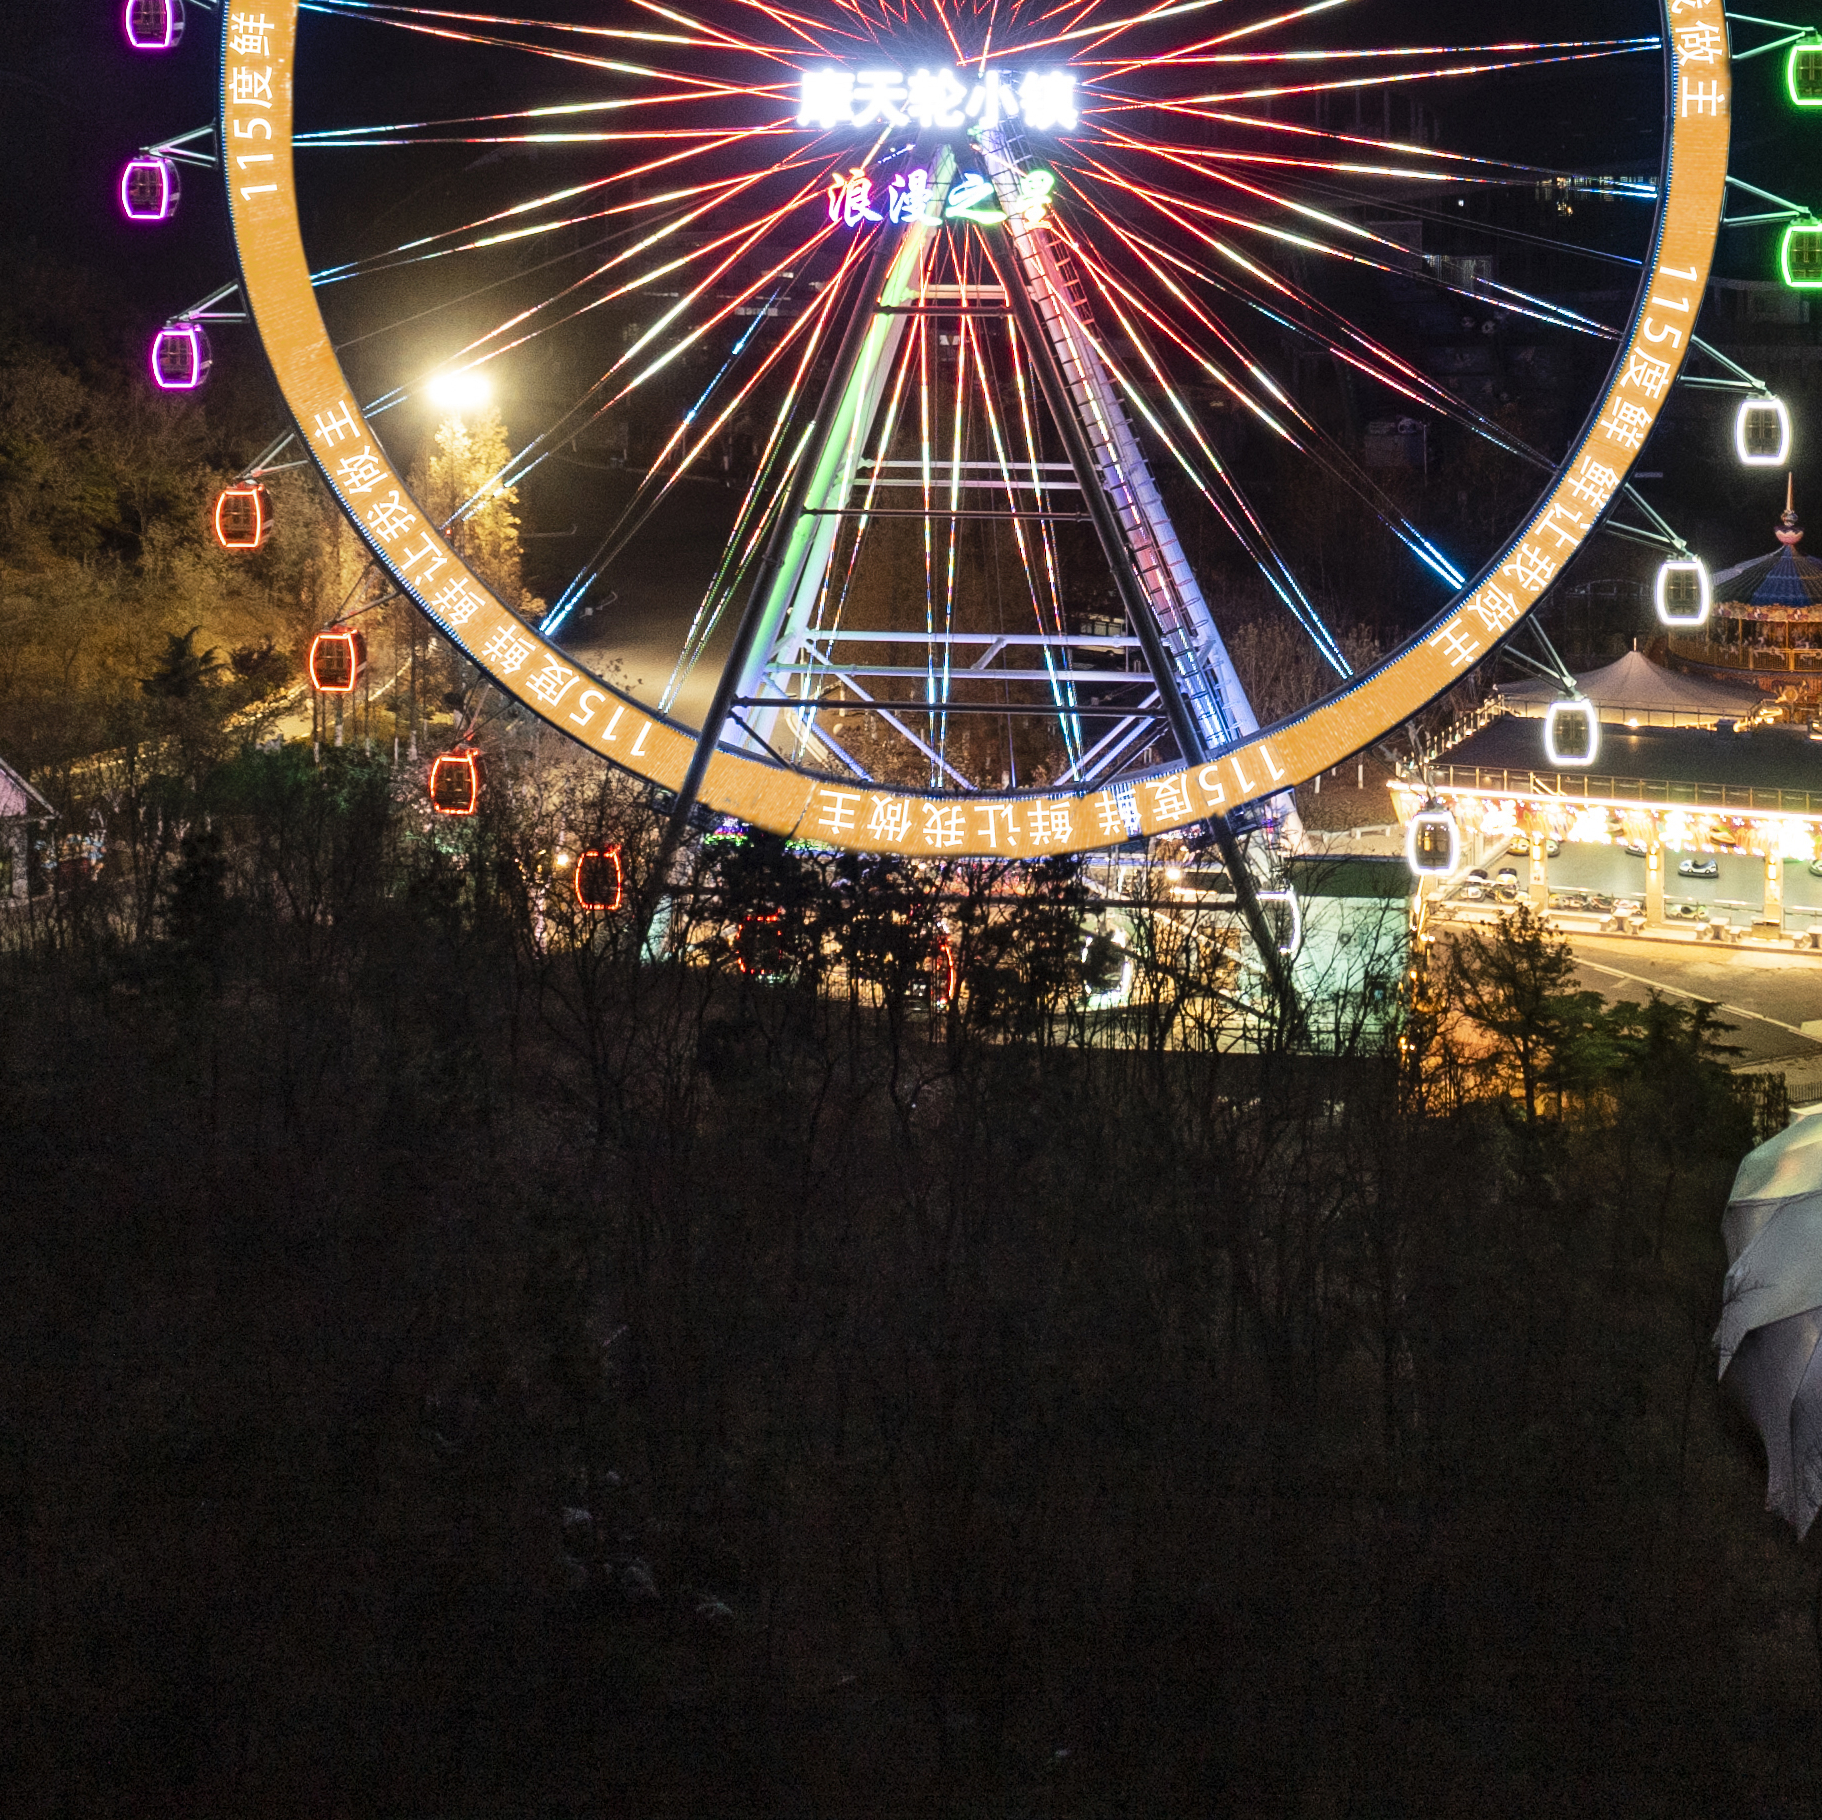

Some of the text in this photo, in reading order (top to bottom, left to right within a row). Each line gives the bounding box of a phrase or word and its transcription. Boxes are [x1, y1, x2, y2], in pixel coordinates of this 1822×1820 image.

[229, 13, 277, 200] 115度鲜
[826, 167, 1056, 231] 浪漫之星
[1428, 266, 1697, 667] 115度鲜 鲜让我做主
[314, 399, 652, 756] 115度鲜 鲜让我做主
[819, 743, 1286, 848] 115度鲜 鲜让我做主
